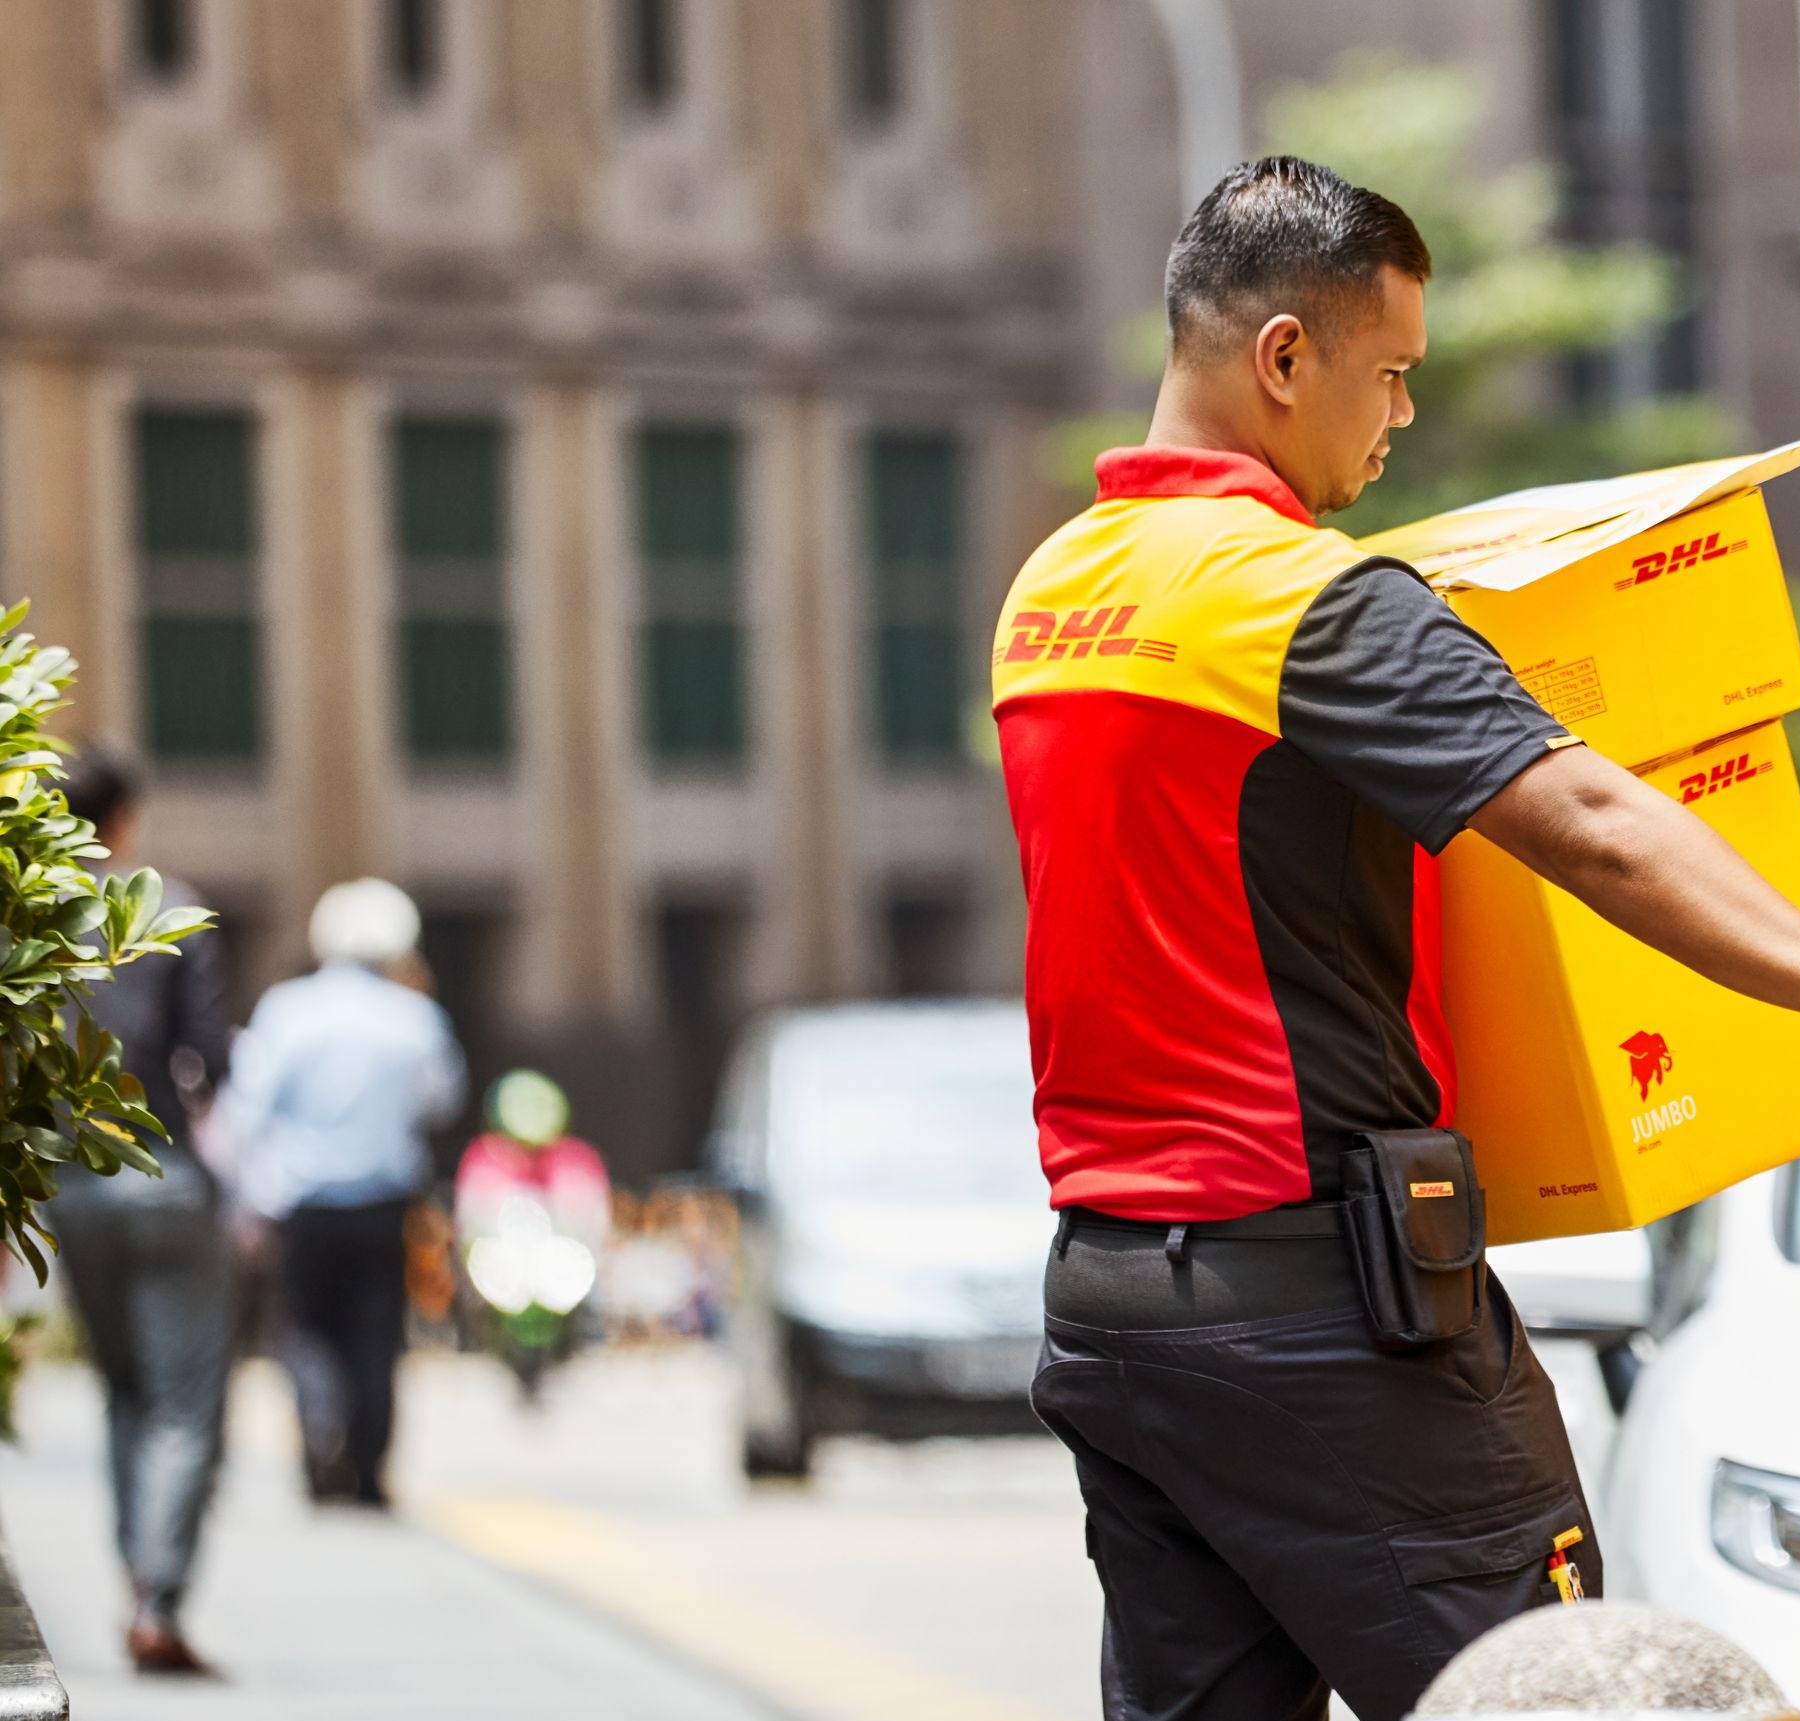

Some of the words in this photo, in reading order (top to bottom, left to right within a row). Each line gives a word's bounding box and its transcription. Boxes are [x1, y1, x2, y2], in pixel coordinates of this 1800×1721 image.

[1631, 532, 1730, 585] DHL
[1003, 605, 1140, 663] DHL
[1723, 690, 1745, 706] DHL
[1746, 679, 1783, 698] Express
[1679, 753, 1758, 805] DHL
[1631, 1095, 1697, 1143] JUMBO
[1538, 1186, 1560, 1198] DHL
[1561, 1182, 1598, 1197] Express
